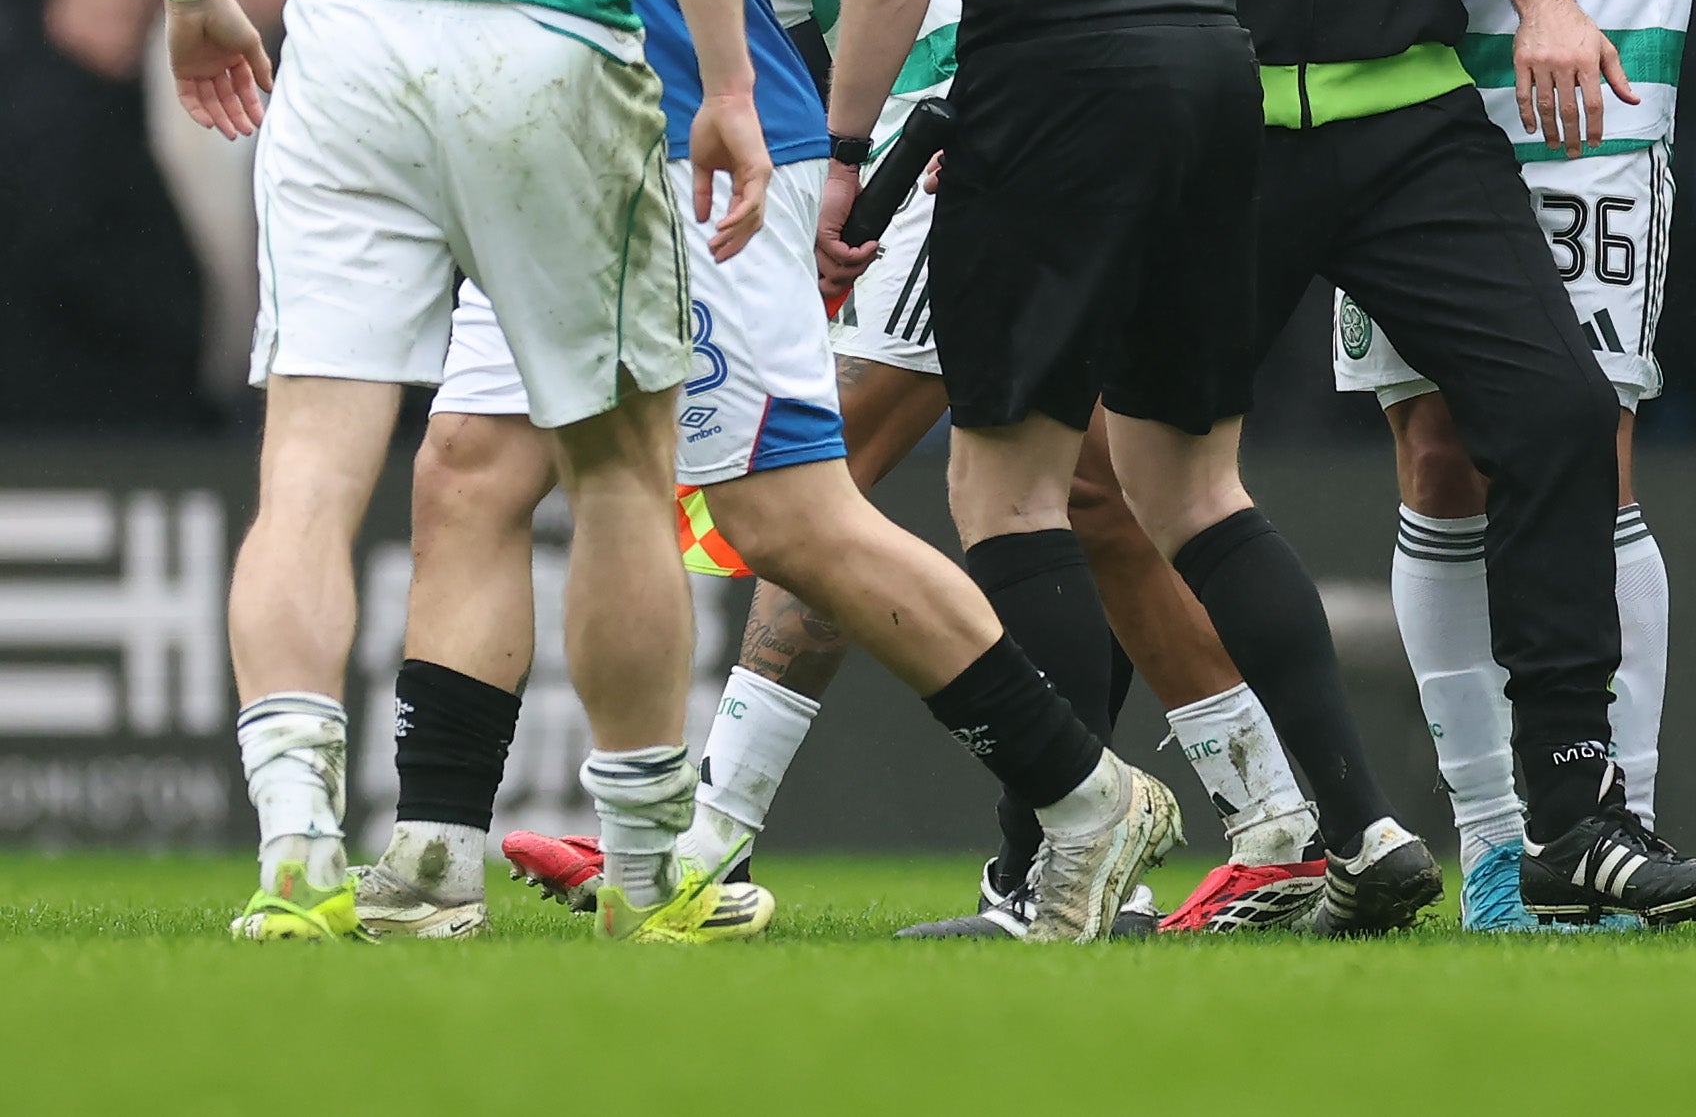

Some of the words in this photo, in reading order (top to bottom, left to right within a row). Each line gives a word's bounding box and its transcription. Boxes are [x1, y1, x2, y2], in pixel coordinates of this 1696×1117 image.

[1541, 194, 1636, 287] 36
[686, 425, 722, 444] umbro
[720, 697, 748, 720] TIC
